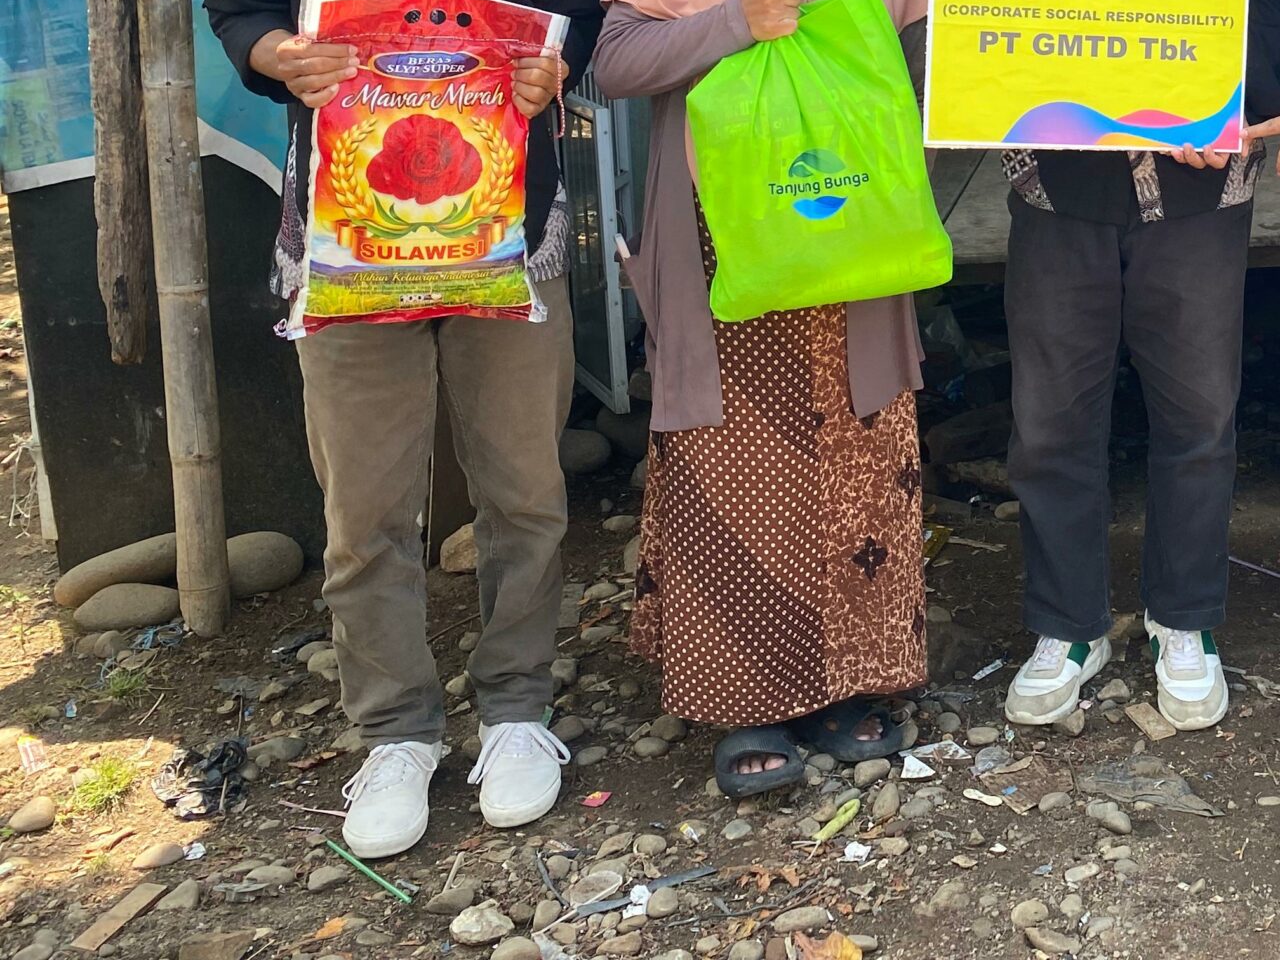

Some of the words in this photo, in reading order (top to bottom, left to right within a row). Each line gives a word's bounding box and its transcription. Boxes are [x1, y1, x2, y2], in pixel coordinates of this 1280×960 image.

[942, 3, 1041, 20] (CORPORATE
[1045, 8, 1101, 22] SOCIAL
[1106, 10, 1235, 29] RESPONSIBILITY)
[979, 31, 1022, 54] PT
[1032, 33, 1128, 59] GMTD
[1139, 37, 1198, 62] Tbk
[386, 64, 420, 74] SLYP
[422, 64, 466, 74] SUPER
[341, 83, 430, 114] Mawar
[430, 82, 505, 114] Merah
[768, 181, 821, 196] Tanjung
[824, 172, 870, 189] Bunga
[359, 239, 485, 261] SULAWESI
